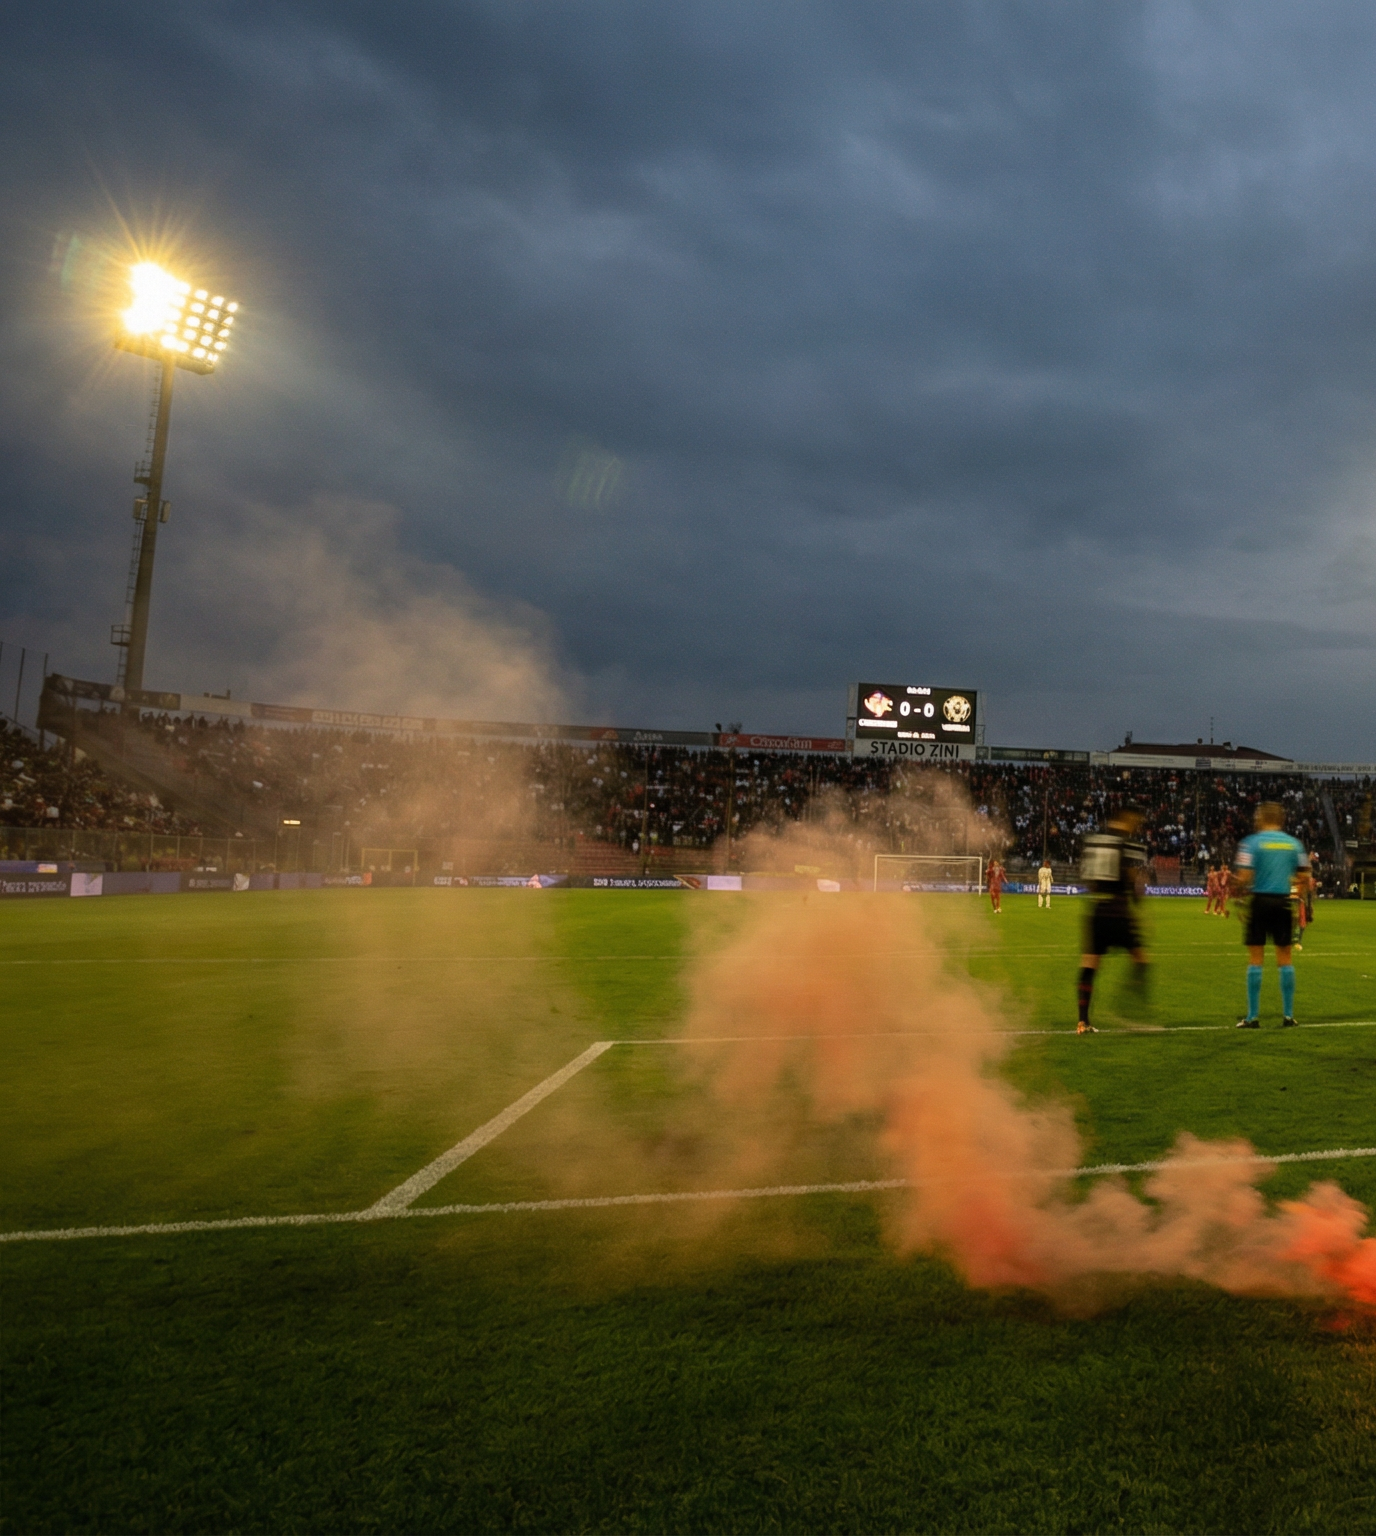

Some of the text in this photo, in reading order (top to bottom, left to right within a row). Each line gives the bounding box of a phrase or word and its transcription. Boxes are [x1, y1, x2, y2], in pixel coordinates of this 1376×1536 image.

[899, 701, 911, 717] 0
[923, 702, 935, 718] 0
[870, 740, 959, 758] STADIO ZINI
